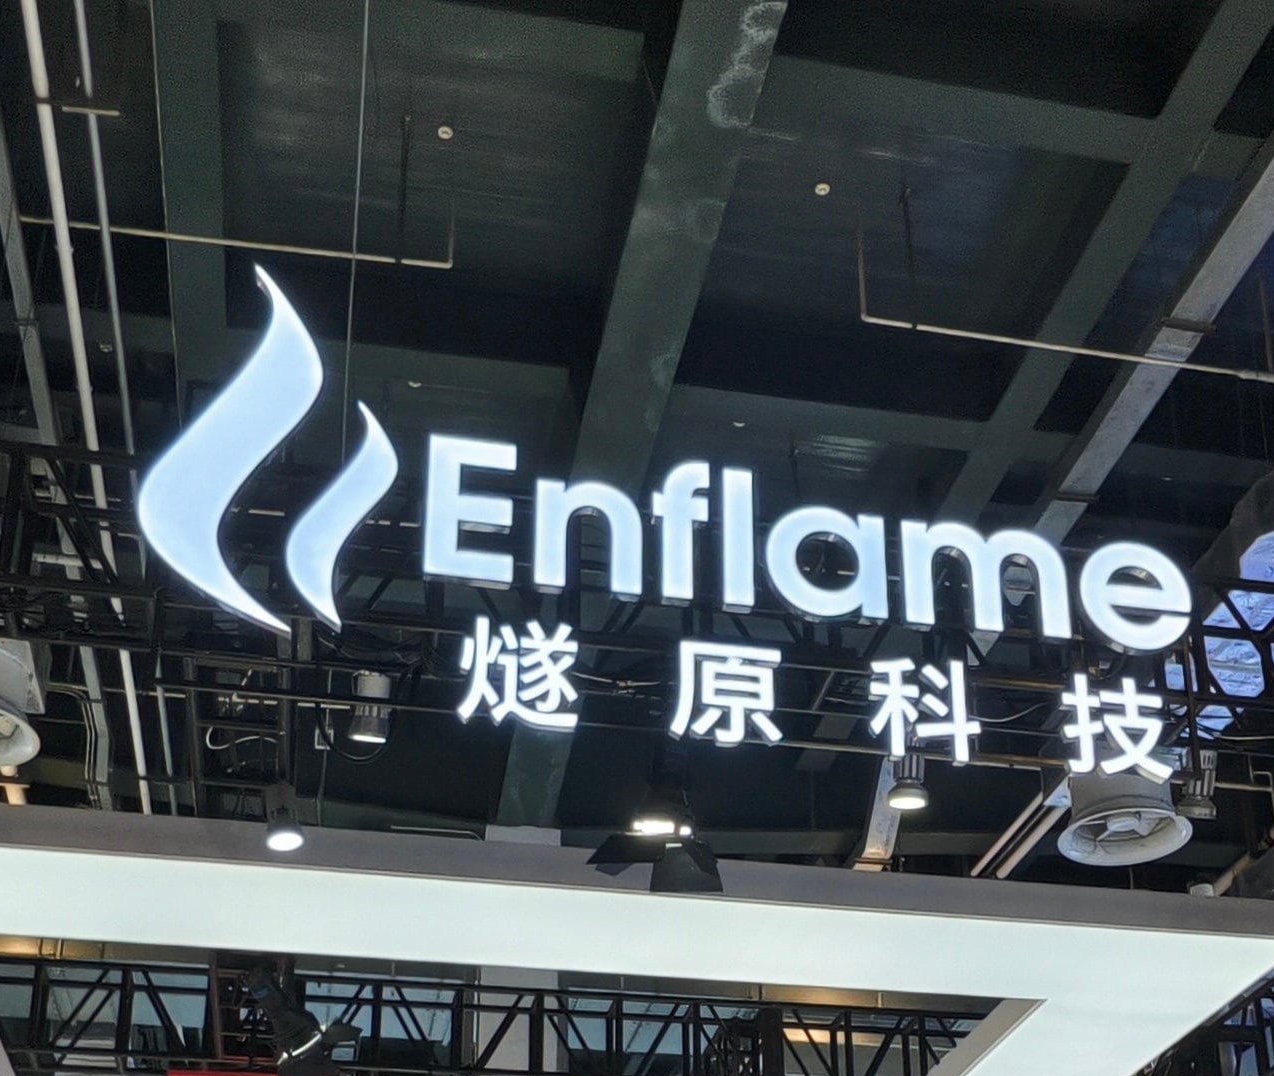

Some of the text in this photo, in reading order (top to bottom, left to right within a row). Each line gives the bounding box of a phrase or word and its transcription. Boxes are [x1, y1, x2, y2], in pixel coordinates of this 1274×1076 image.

[424, 434, 1193, 656] Enflame
[456, 618, 1177, 785] 燧原科技
